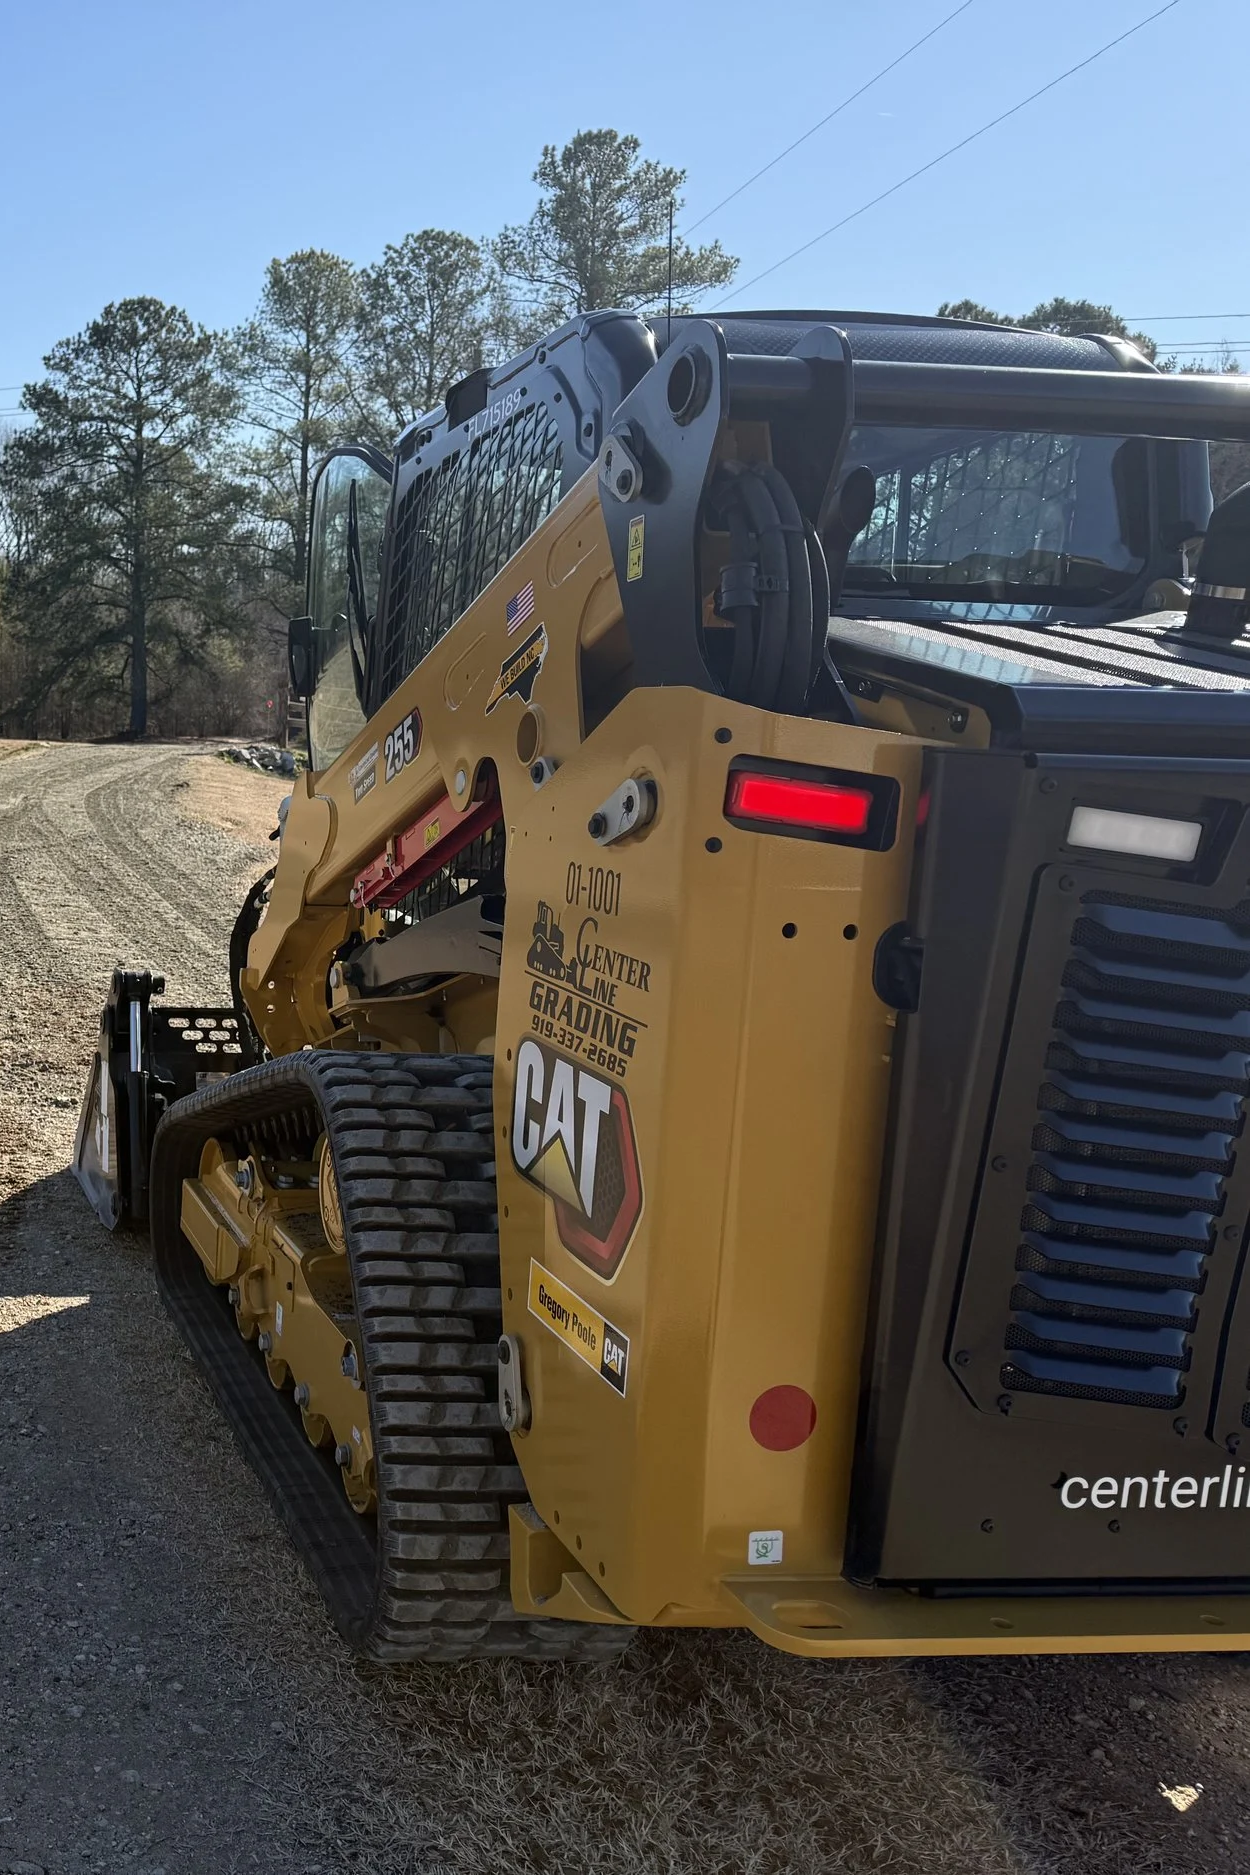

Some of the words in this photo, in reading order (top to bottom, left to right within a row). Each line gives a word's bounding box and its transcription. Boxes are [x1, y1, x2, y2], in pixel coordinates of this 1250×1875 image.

[467, 388, 521, 441] FL715189
[500, 674, 510, 689] WE
[510, 657, 526, 680] BUILD
[384, 714, 414, 782] 255
[565, 861, 622, 916] 01-1001
[529, 980, 639, 1058] GRADING
[531, 1014, 628, 1078] 919-337-2685
[512, 1040, 612, 1219] CAT
[538, 1284, 570, 1330] Gregory
[571, 1312, 597, 1351] Poole
[604, 1337, 625, 1377] CAT
[1061, 1464, 1250, 1509] centerli
